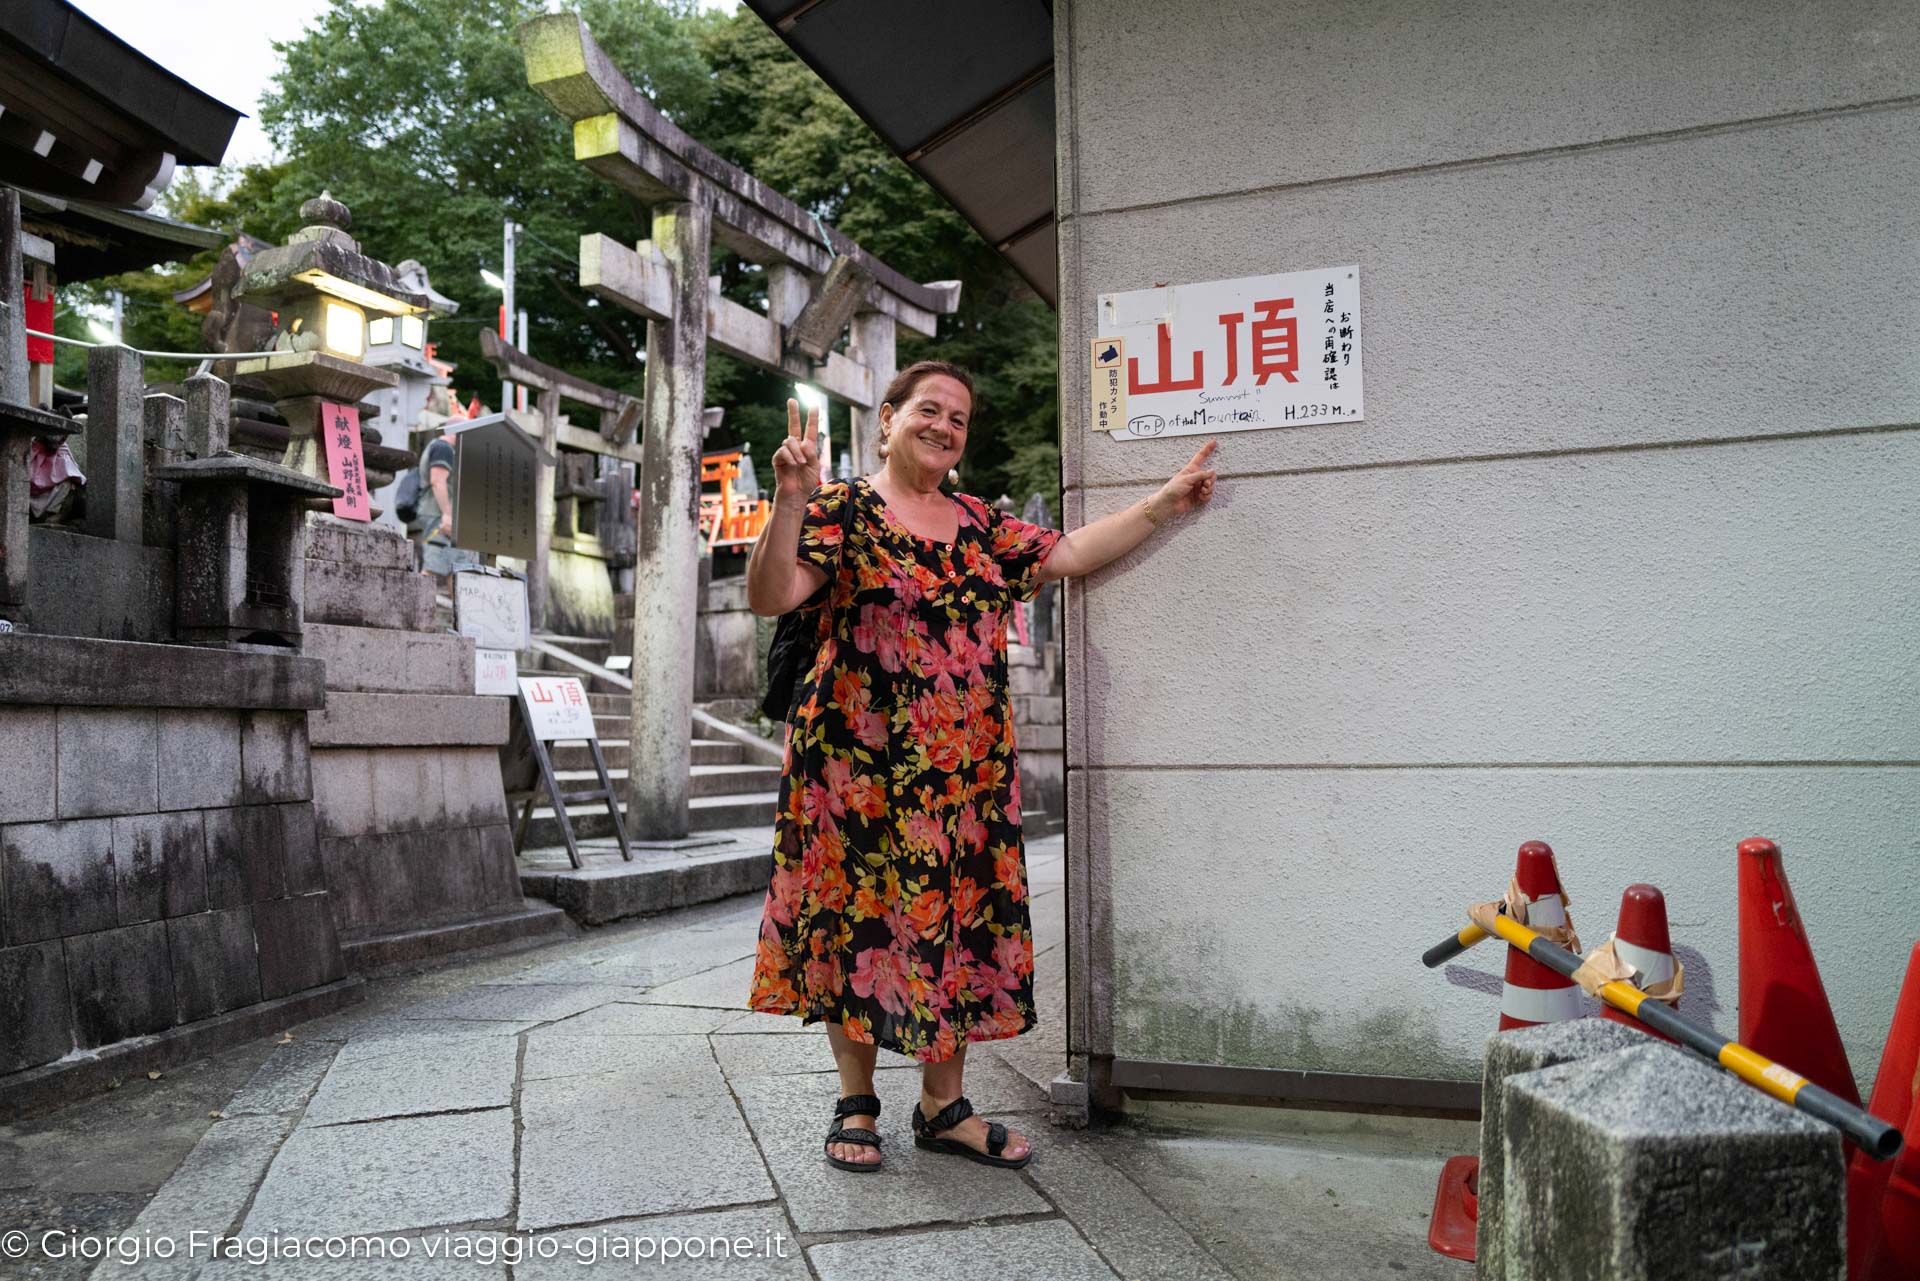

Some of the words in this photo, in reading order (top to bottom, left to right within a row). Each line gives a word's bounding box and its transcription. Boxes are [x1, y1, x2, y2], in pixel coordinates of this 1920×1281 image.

[1128, 298, 1300, 395] 山頂
[1339, 311, 1354, 366] お断わり
[1109, 369, 1118, 414] 防犯カメラ
[1099, 402, 1108, 428] 作動中
[1168, 414, 1181, 427] of
[1182, 416, 1194, 427] the
[335, 415, 352, 450] 献燈
[459, 586, 480, 597] MAP
[531, 681, 582, 706] 山頂
